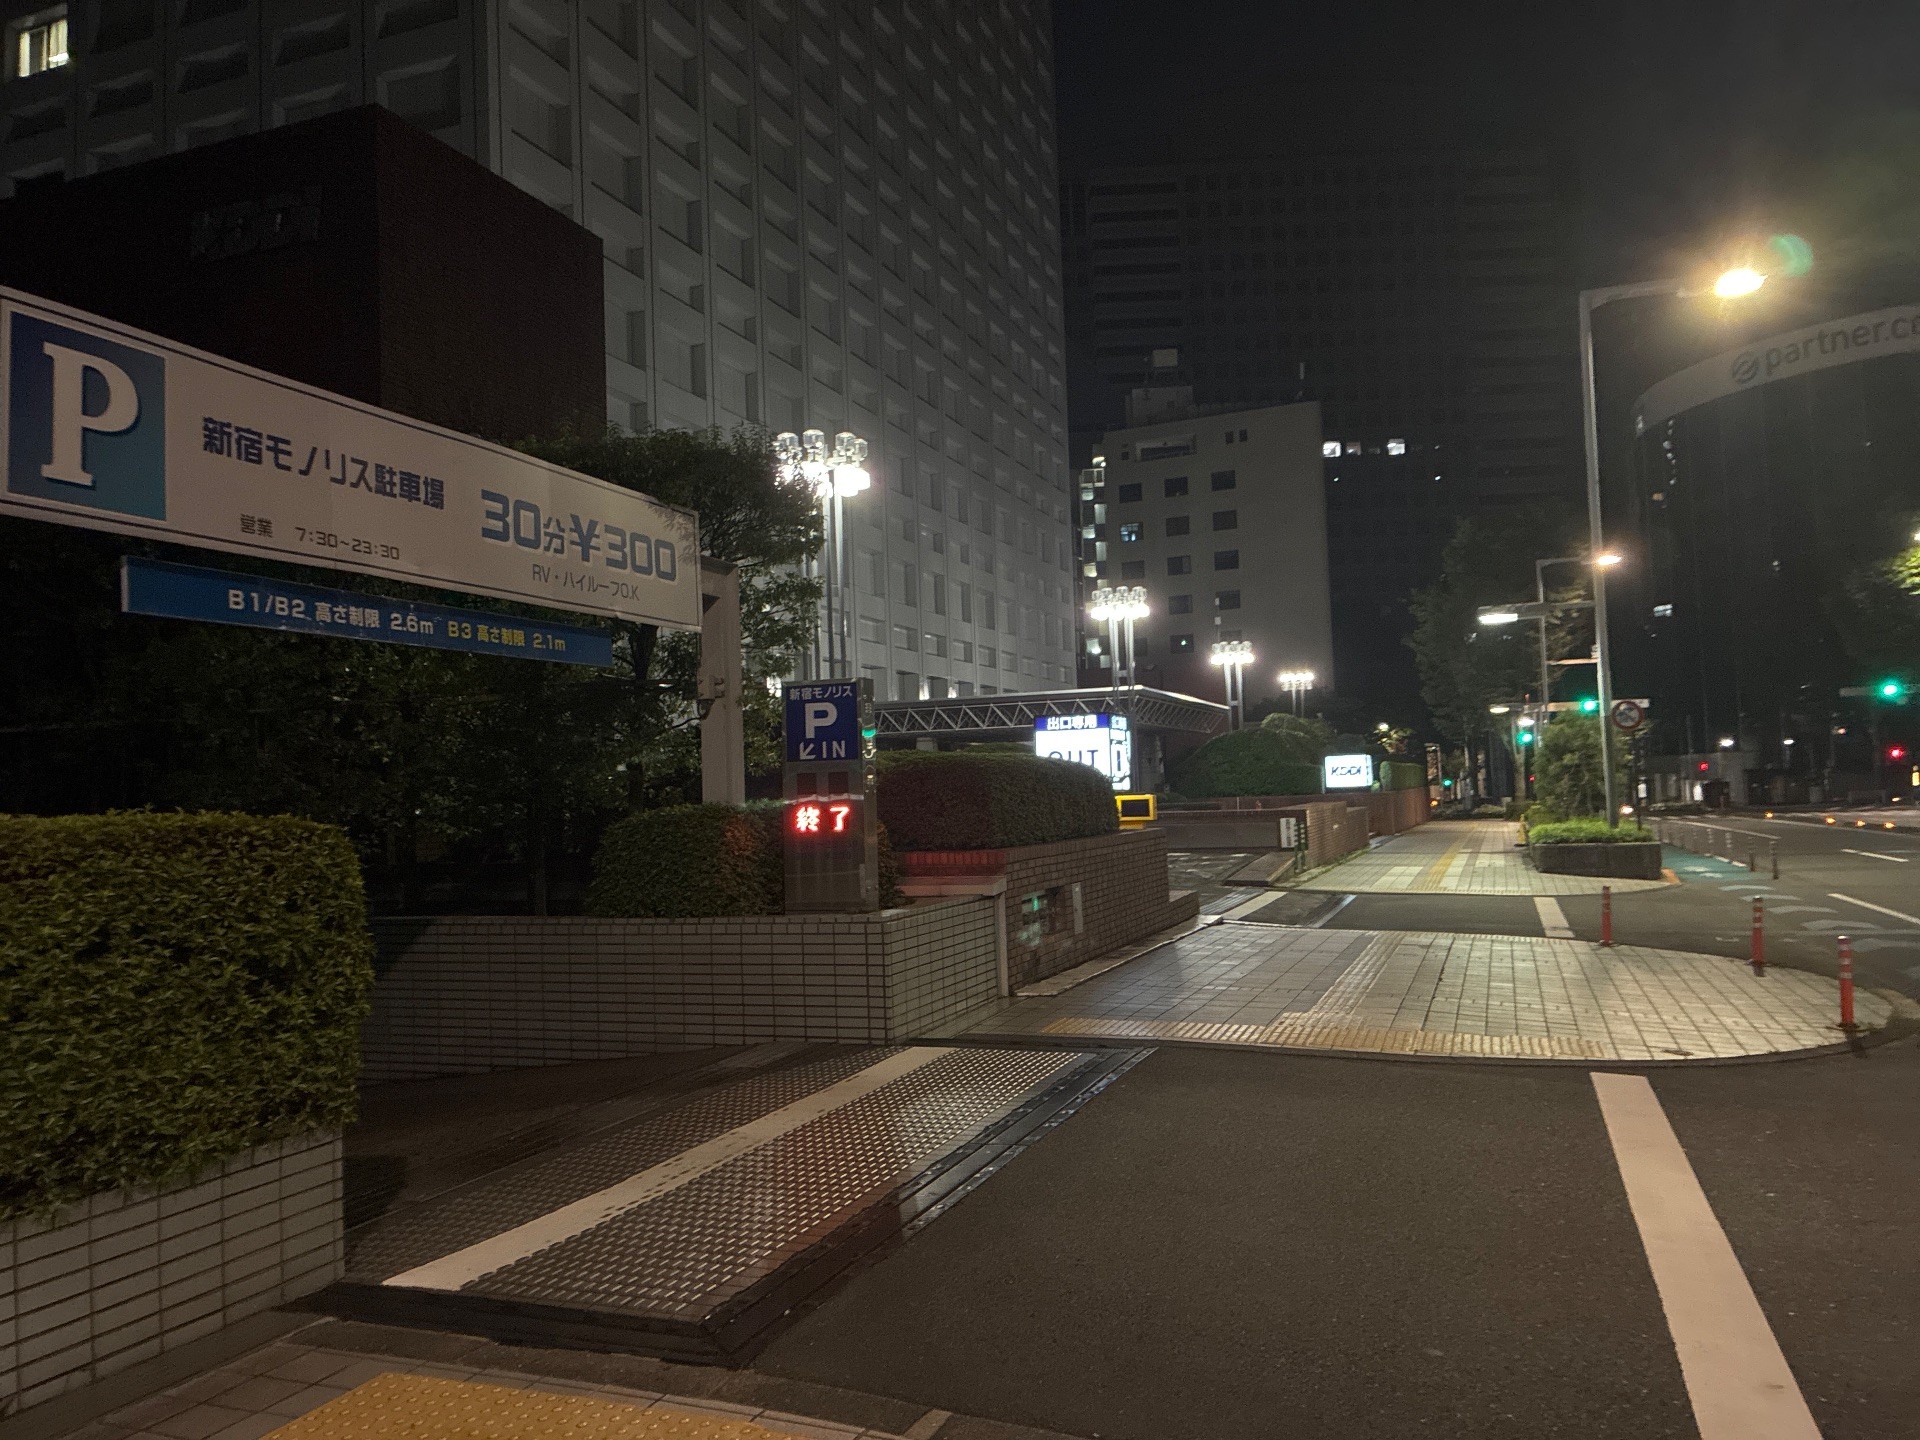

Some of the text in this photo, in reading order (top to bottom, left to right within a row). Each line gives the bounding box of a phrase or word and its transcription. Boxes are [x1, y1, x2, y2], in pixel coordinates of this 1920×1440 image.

[40, 341, 139, 487] P
[203, 416, 446, 510] 新宿モノリス駐車場
[240, 513, 273, 538] 営業
[228, 589, 566, 651] B1/B2 高さ制限 2.6m B3 高さ制限 2.1m
[789, 685, 853, 701] 新宿モノリス
[804, 701, 838, 740] P
[822, 740, 846, 760] IN
[796, 805, 850, 832] 終了
